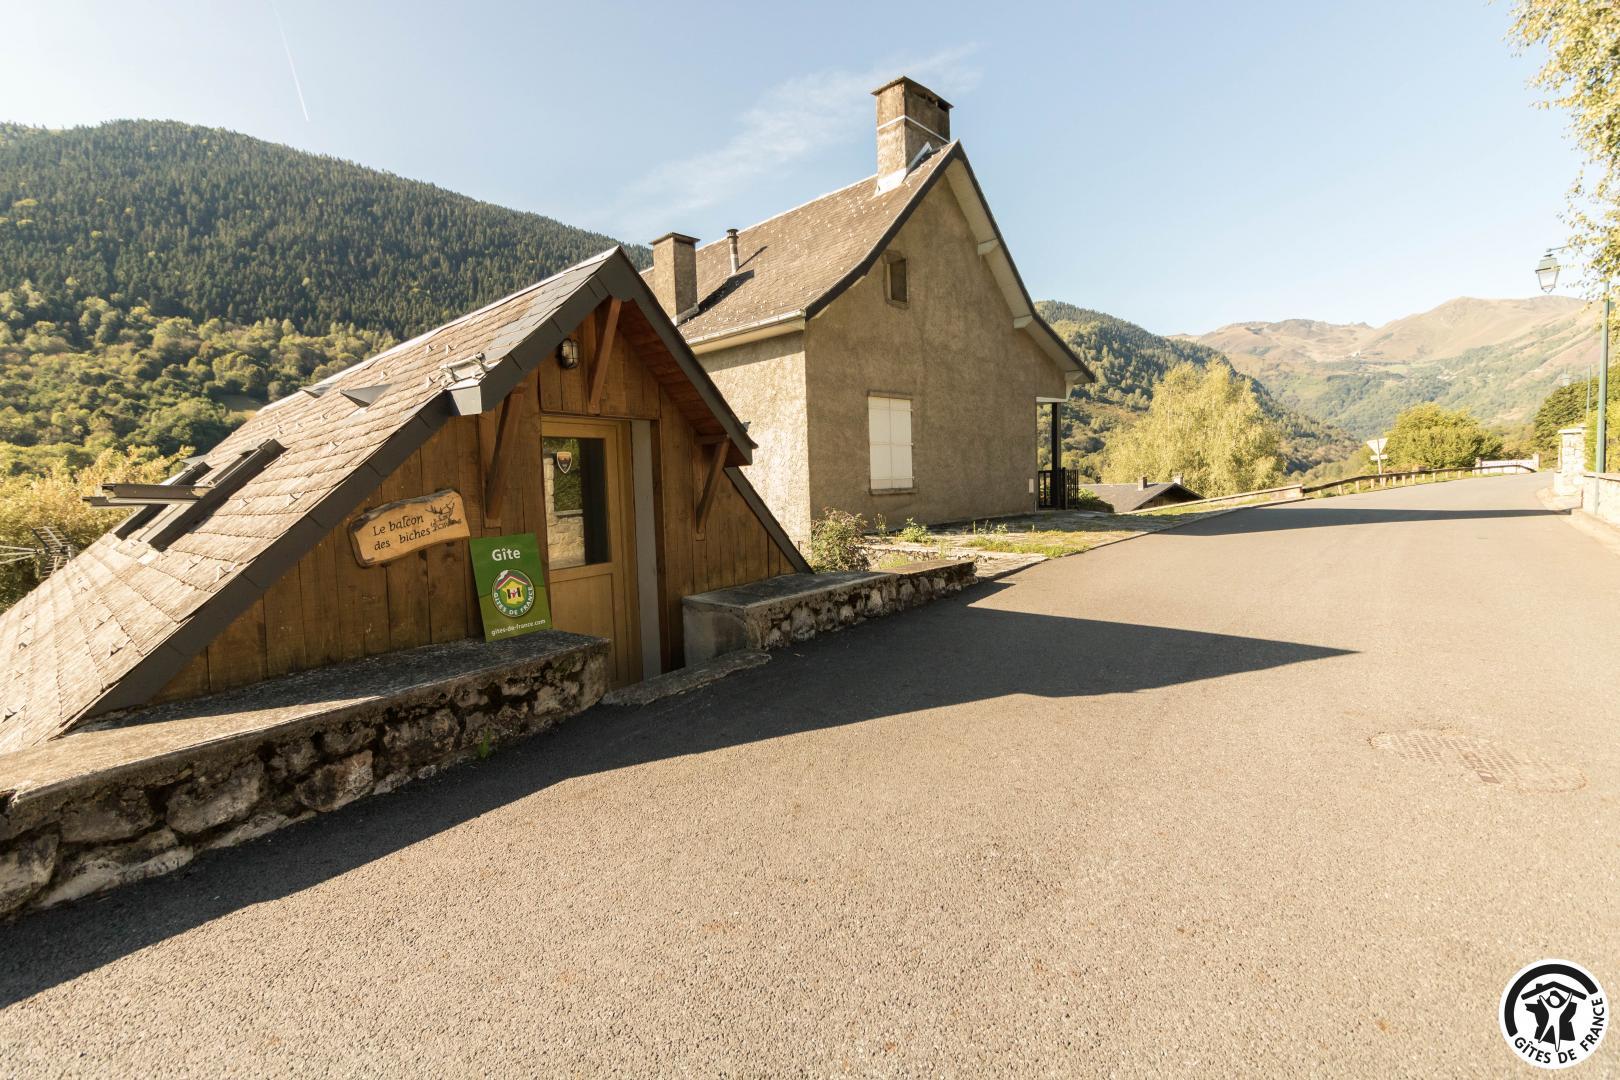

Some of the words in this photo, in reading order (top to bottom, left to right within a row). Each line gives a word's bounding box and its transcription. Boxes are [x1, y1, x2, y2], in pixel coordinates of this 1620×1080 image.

[372, 525, 386, 537] Le
[389, 514, 424, 532] balcon
[374, 540, 391, 551] des
[399, 528, 431, 544] biches
[492, 548, 520, 561] Gîte
[520, 586, 534, 613] FRANCE
